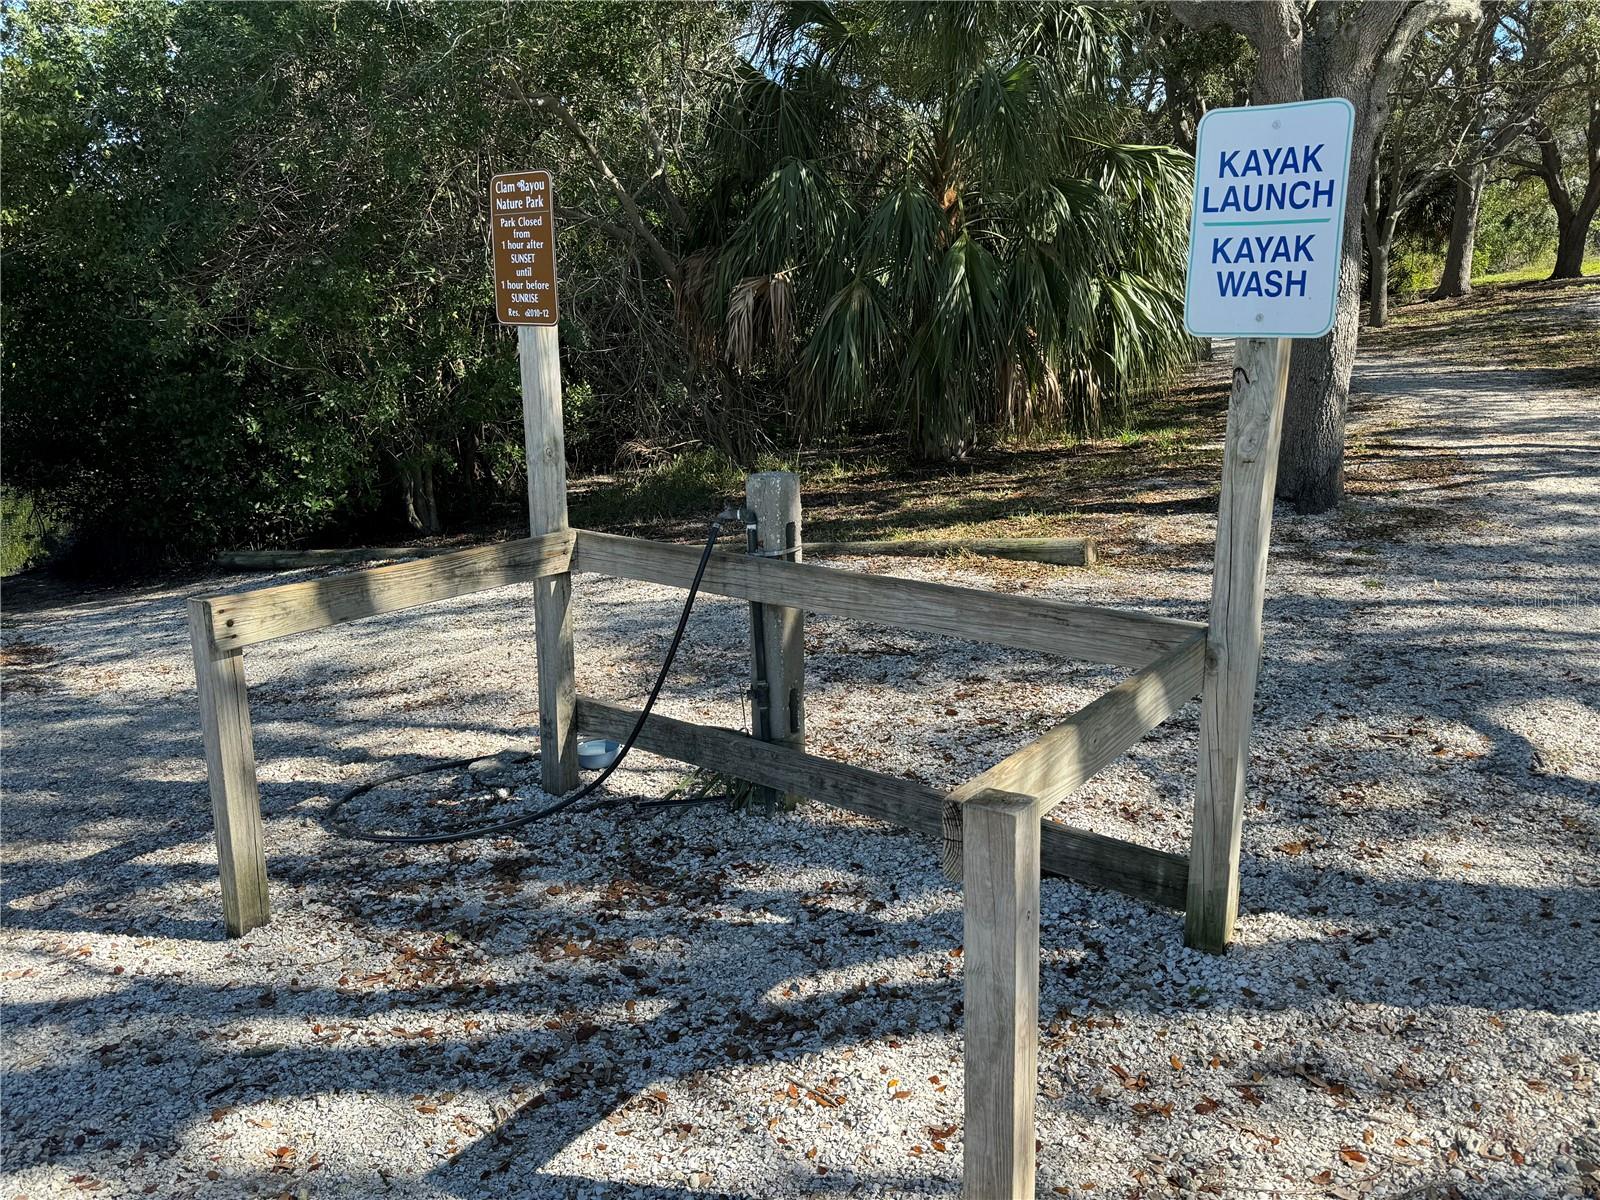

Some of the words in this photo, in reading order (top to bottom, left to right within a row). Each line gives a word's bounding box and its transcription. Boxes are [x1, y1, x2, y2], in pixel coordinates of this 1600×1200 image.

[1218, 143, 1325, 179] KAYAK
[495, 180, 515, 194] Clam
[519, 179, 545, 195] Bayou
[1202, 179, 1335, 213] LAUNCH
[496, 198, 523, 210] Nature
[525, 195, 544, 208] Park
[500, 217, 516, 228] Park
[517, 216, 543, 227] Closed
[513, 228, 531, 239] from
[501, 240, 506, 250] 1
[507, 240, 524, 250] hour
[526, 240, 544, 249] after
[1211, 234, 1316, 264] KAYAK
[510, 253, 536, 264] SUNSET
[515, 266, 532, 277] until
[500, 280, 506, 290] 1
[506, 279, 524, 290] hour
[525, 279, 550, 290] before
[1216, 269, 1308, 298] WASH
[511, 293, 539, 303] SUNRISE
[507, 307, 521, 317] Res.
